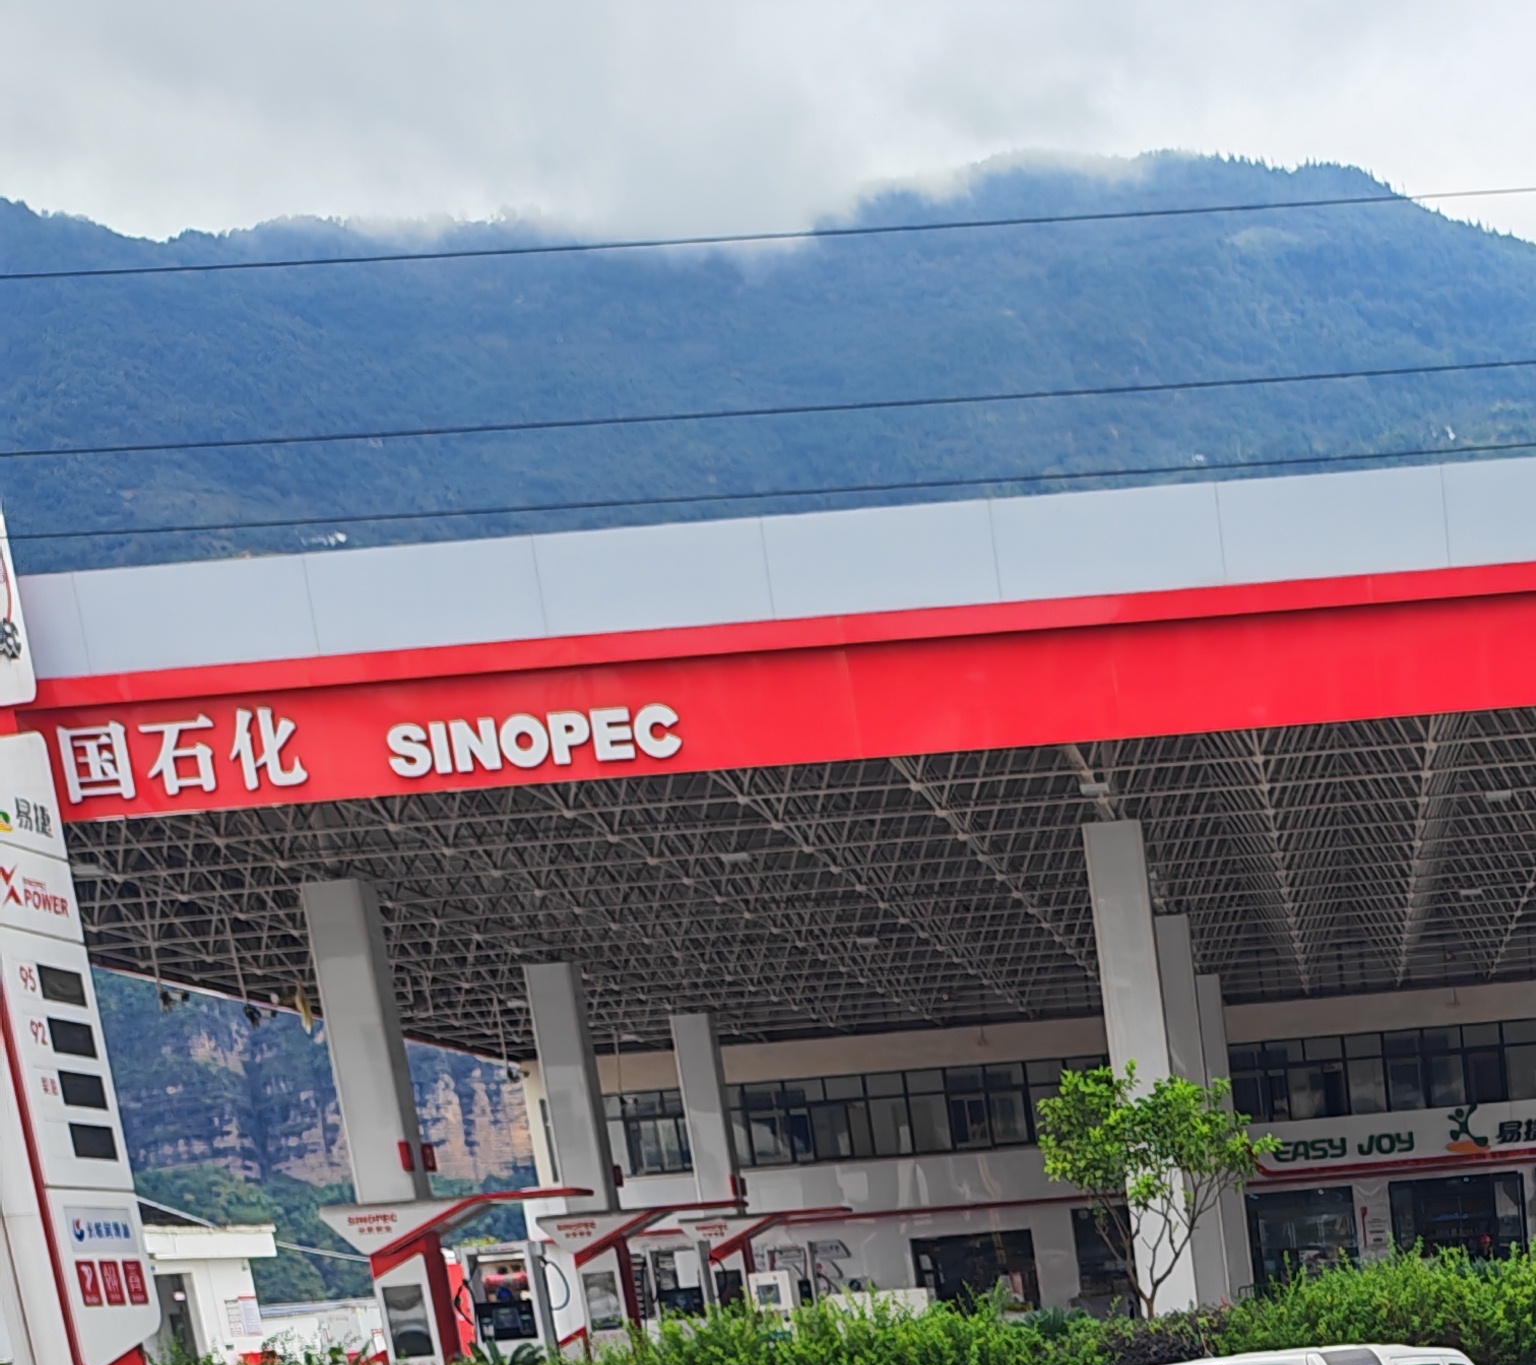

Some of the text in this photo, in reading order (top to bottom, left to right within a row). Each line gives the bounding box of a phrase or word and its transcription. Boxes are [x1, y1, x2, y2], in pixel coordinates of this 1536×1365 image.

[56, 706, 308, 804] 国石化
[386, 703, 682, 778] SINOPEC
[23, 888, 70, 918] POWER
[19, 964, 37, 993] 95
[30, 1019, 48, 1046] 92
[1273, 1130, 1414, 1163] EASY JOY
